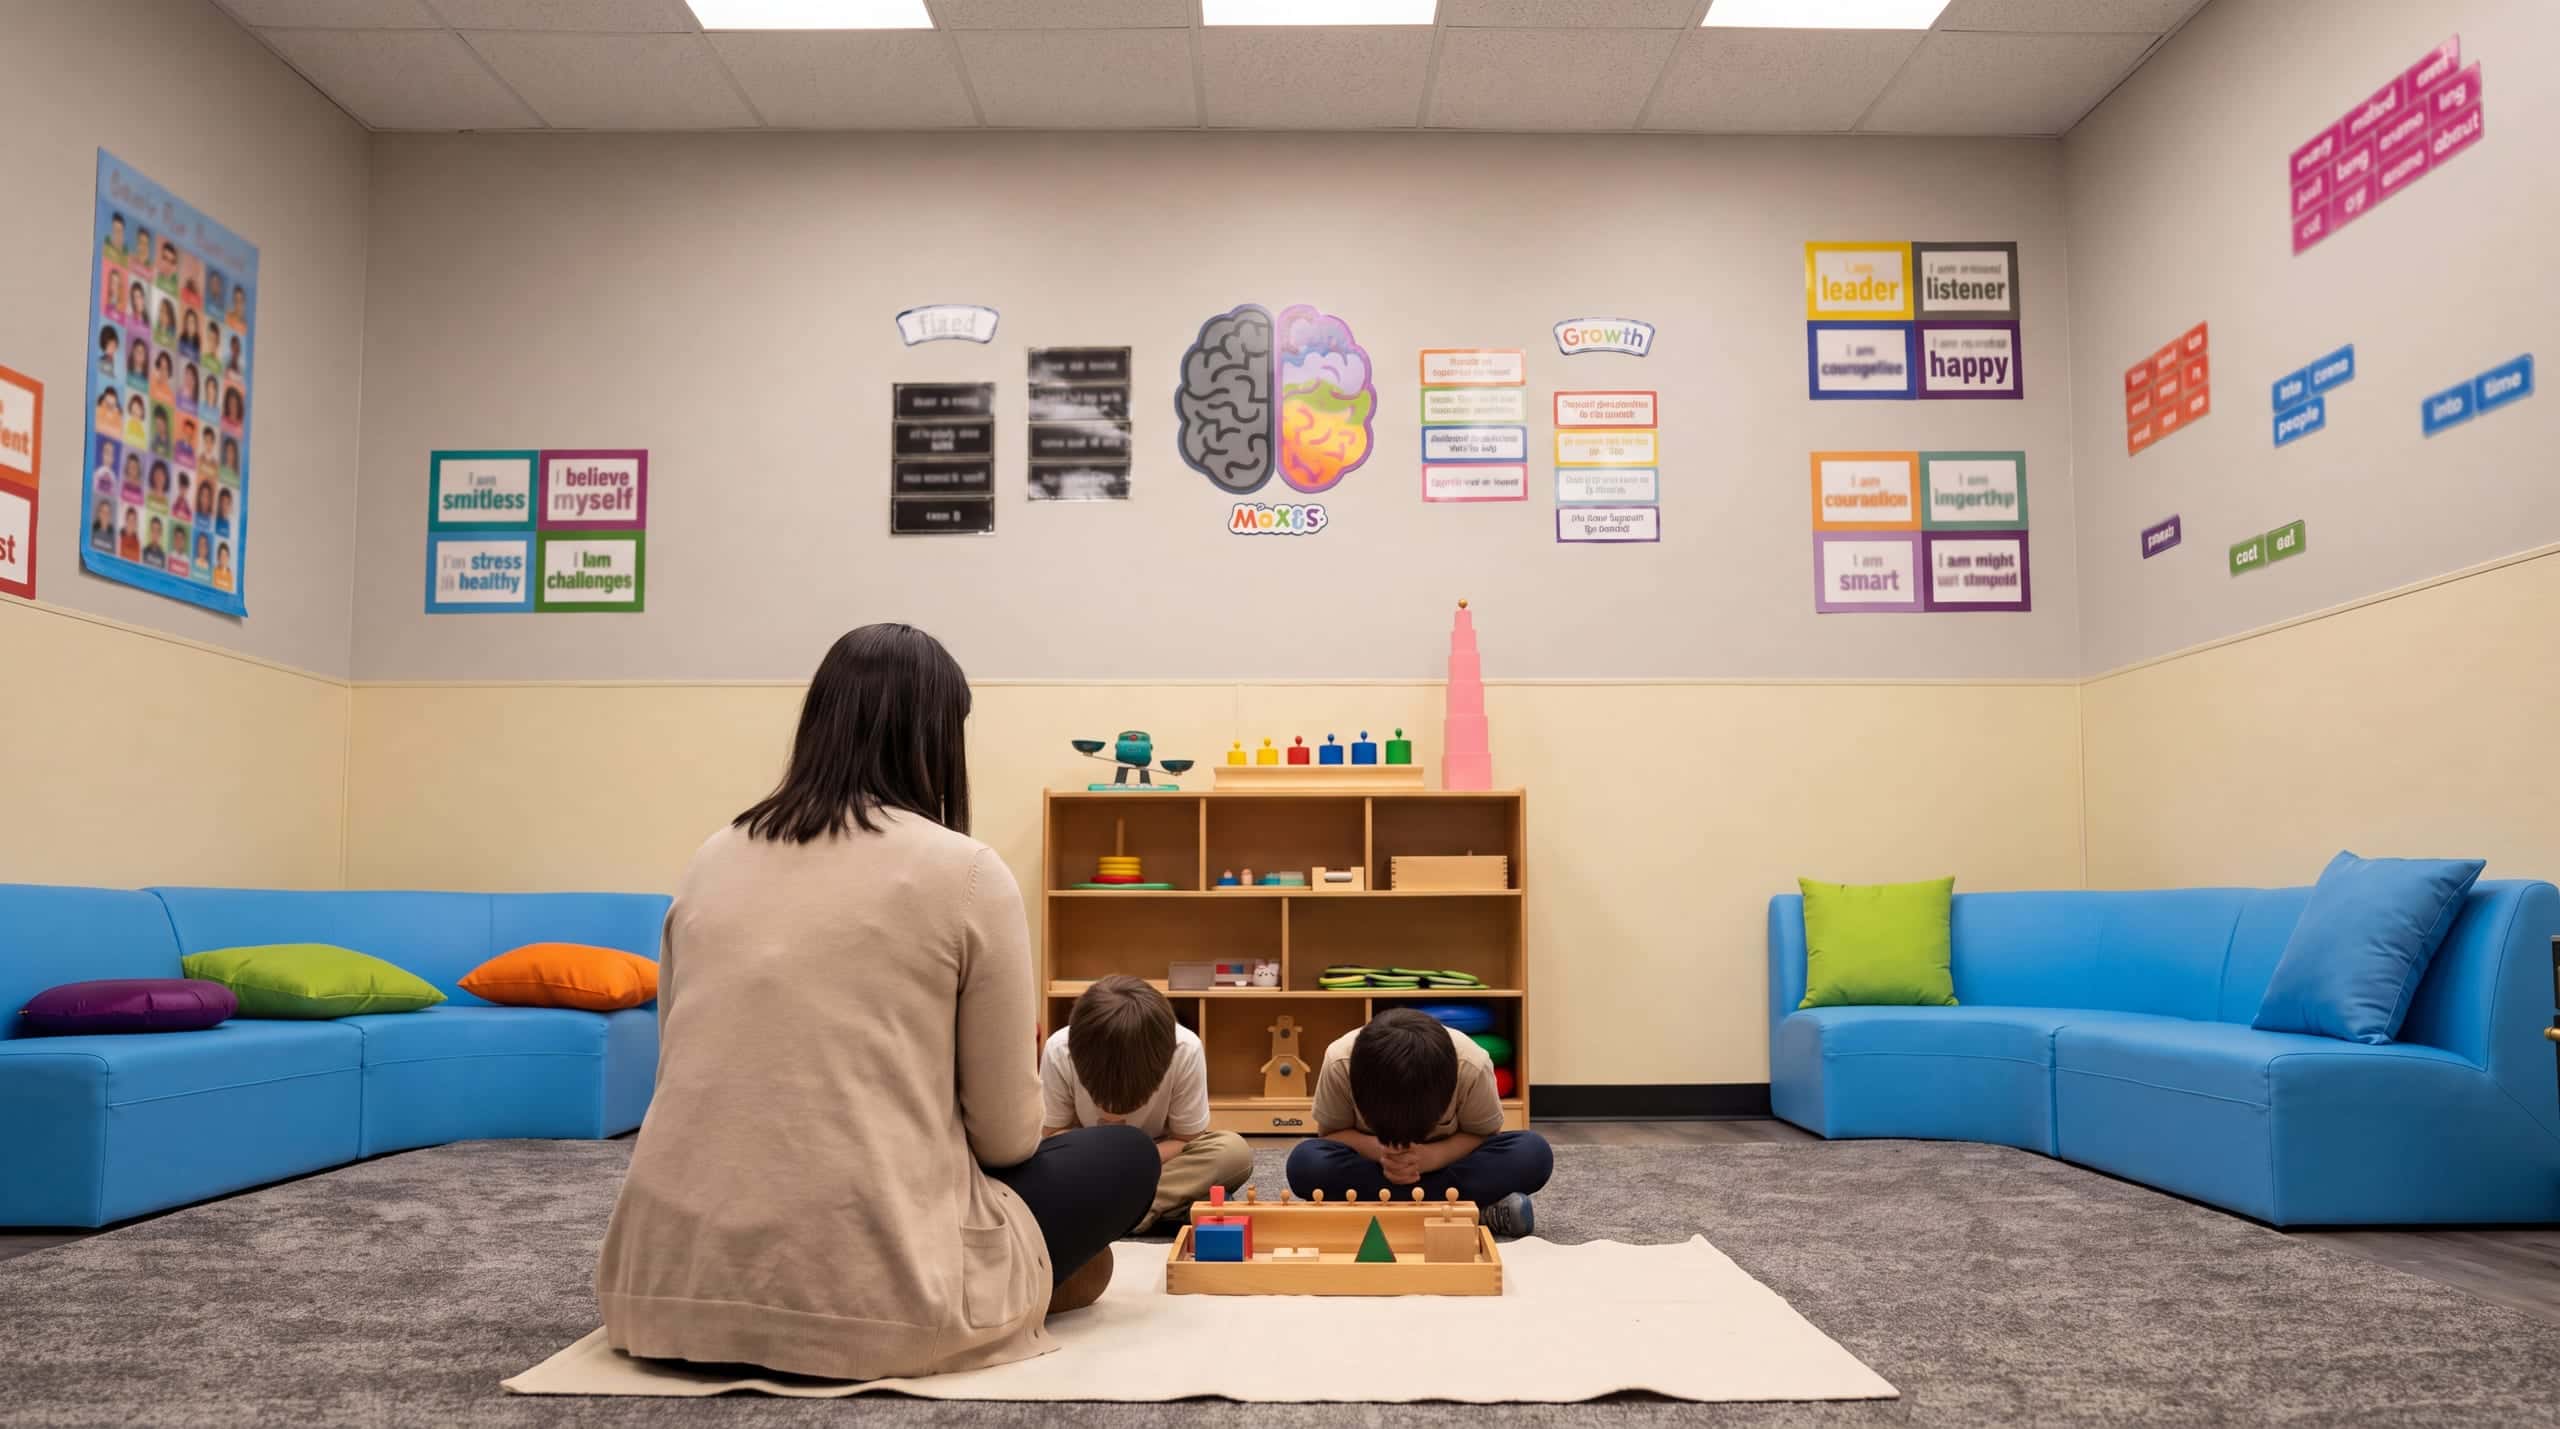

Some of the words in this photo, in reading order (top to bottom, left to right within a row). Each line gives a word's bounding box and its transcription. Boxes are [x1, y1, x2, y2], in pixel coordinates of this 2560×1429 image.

[1822, 275, 1899, 302] leader
[1926, 277, 2006, 300] listener
[1563, 327, 1643, 347] Growth
[1930, 350, 2009, 384] happy
[0, 428, 29, 457] ent
[566, 467, 629, 486] believe
[554, 488, 633, 516] myself
[471, 552, 522, 570] stress
[1948, 555, 1971, 568] am
[1976, 553, 2015, 570] might
[459, 572, 520, 593] healthy
[546, 571, 632, 593] challenges
[1840, 570, 1899, 591] smart
